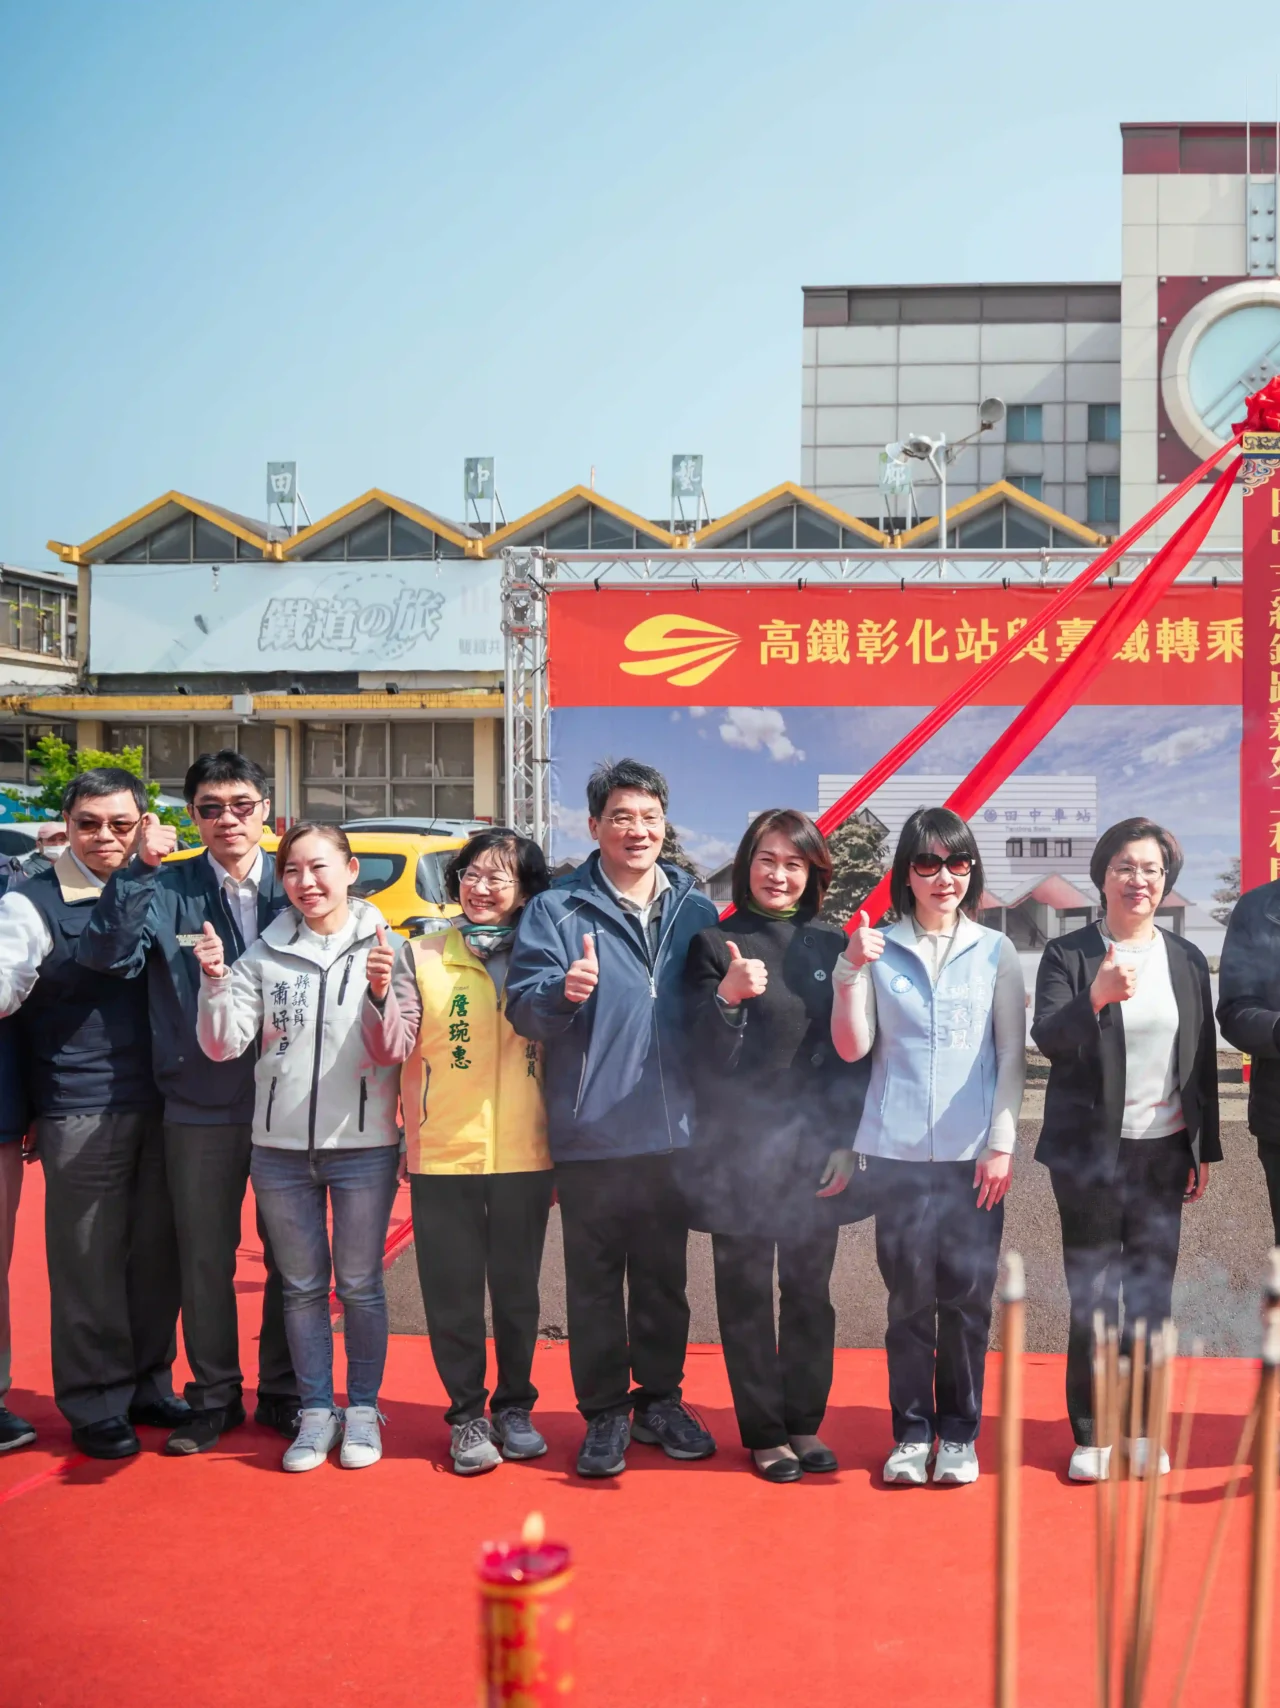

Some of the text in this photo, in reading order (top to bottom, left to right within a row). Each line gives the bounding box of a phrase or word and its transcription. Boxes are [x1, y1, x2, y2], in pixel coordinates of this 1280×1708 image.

[291, 973, 310, 1027] 縣議員
[525, 1041, 539, 1078] 議員
